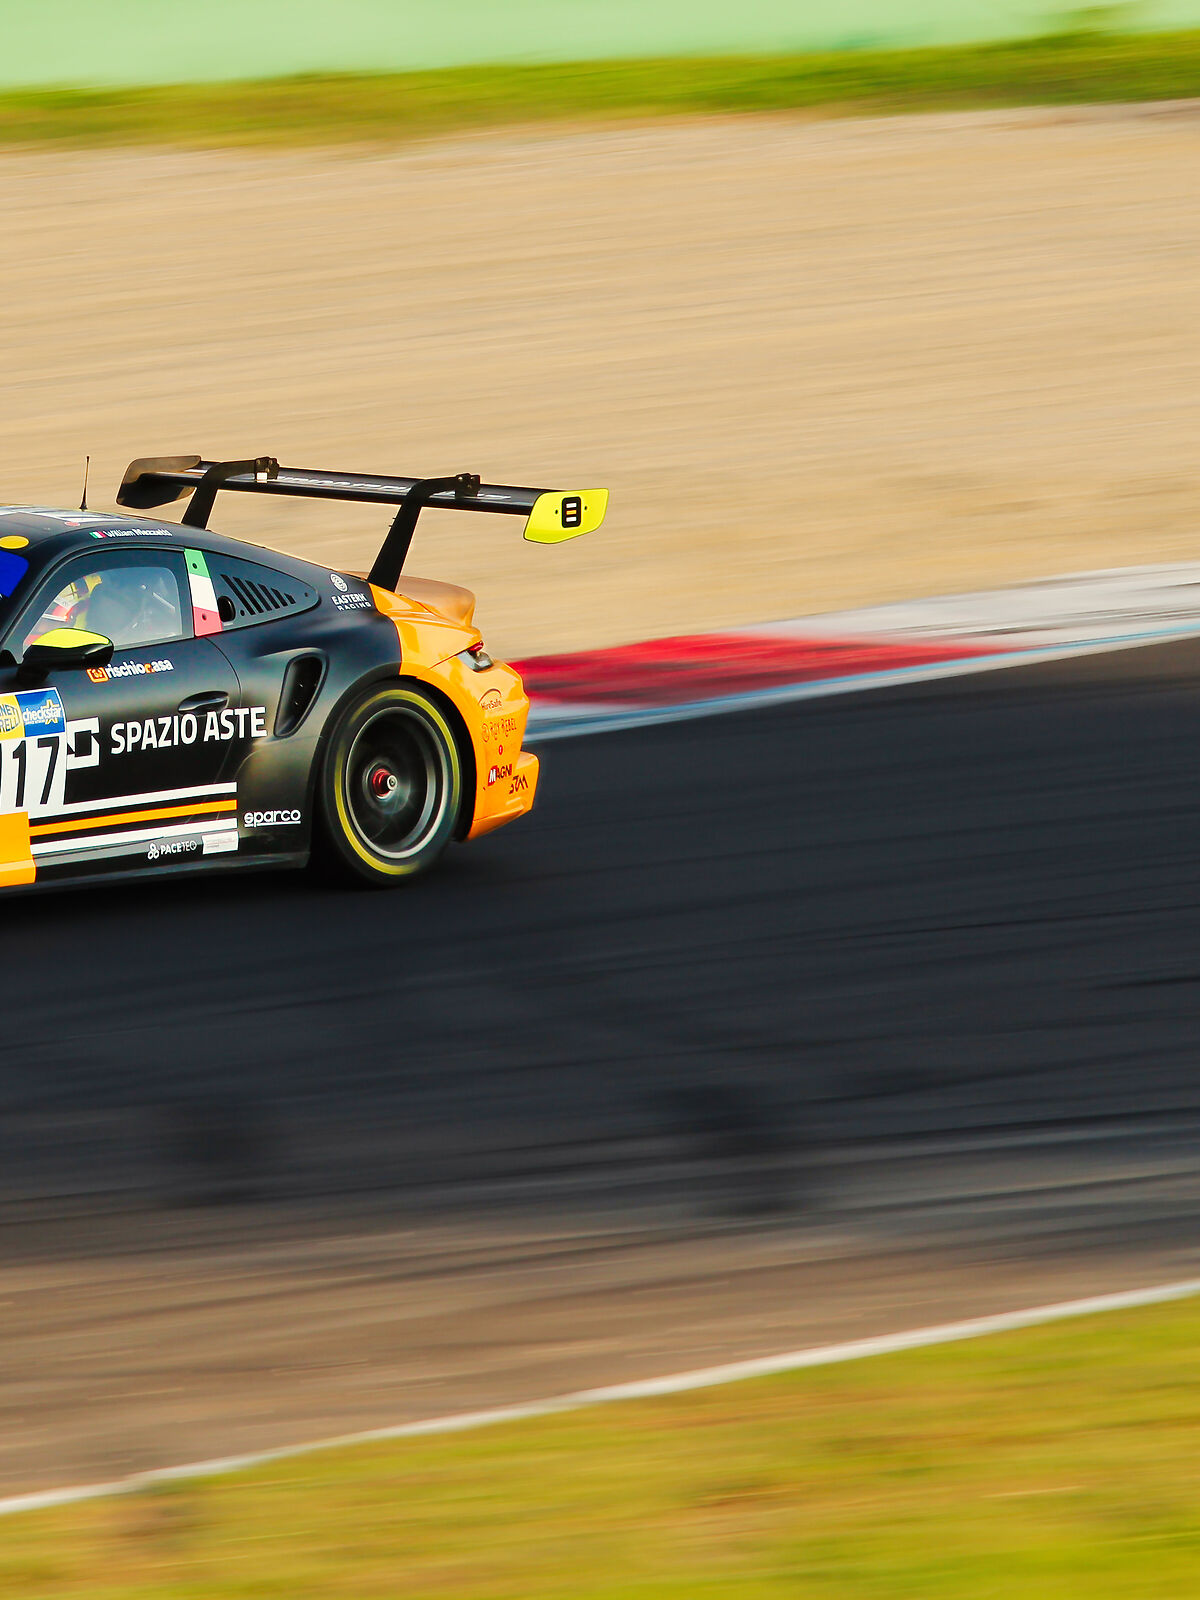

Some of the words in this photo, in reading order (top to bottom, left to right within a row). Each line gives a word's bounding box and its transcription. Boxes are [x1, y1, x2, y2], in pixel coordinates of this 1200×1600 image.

[331, 593, 368, 606] EASTERN
[337, 601, 372, 611] RACING
[22, 706, 62, 722] checkstar
[110, 713, 198, 755] SPAZIO
[203, 706, 268, 742] ASTE
[244, 809, 301, 827] sparco
